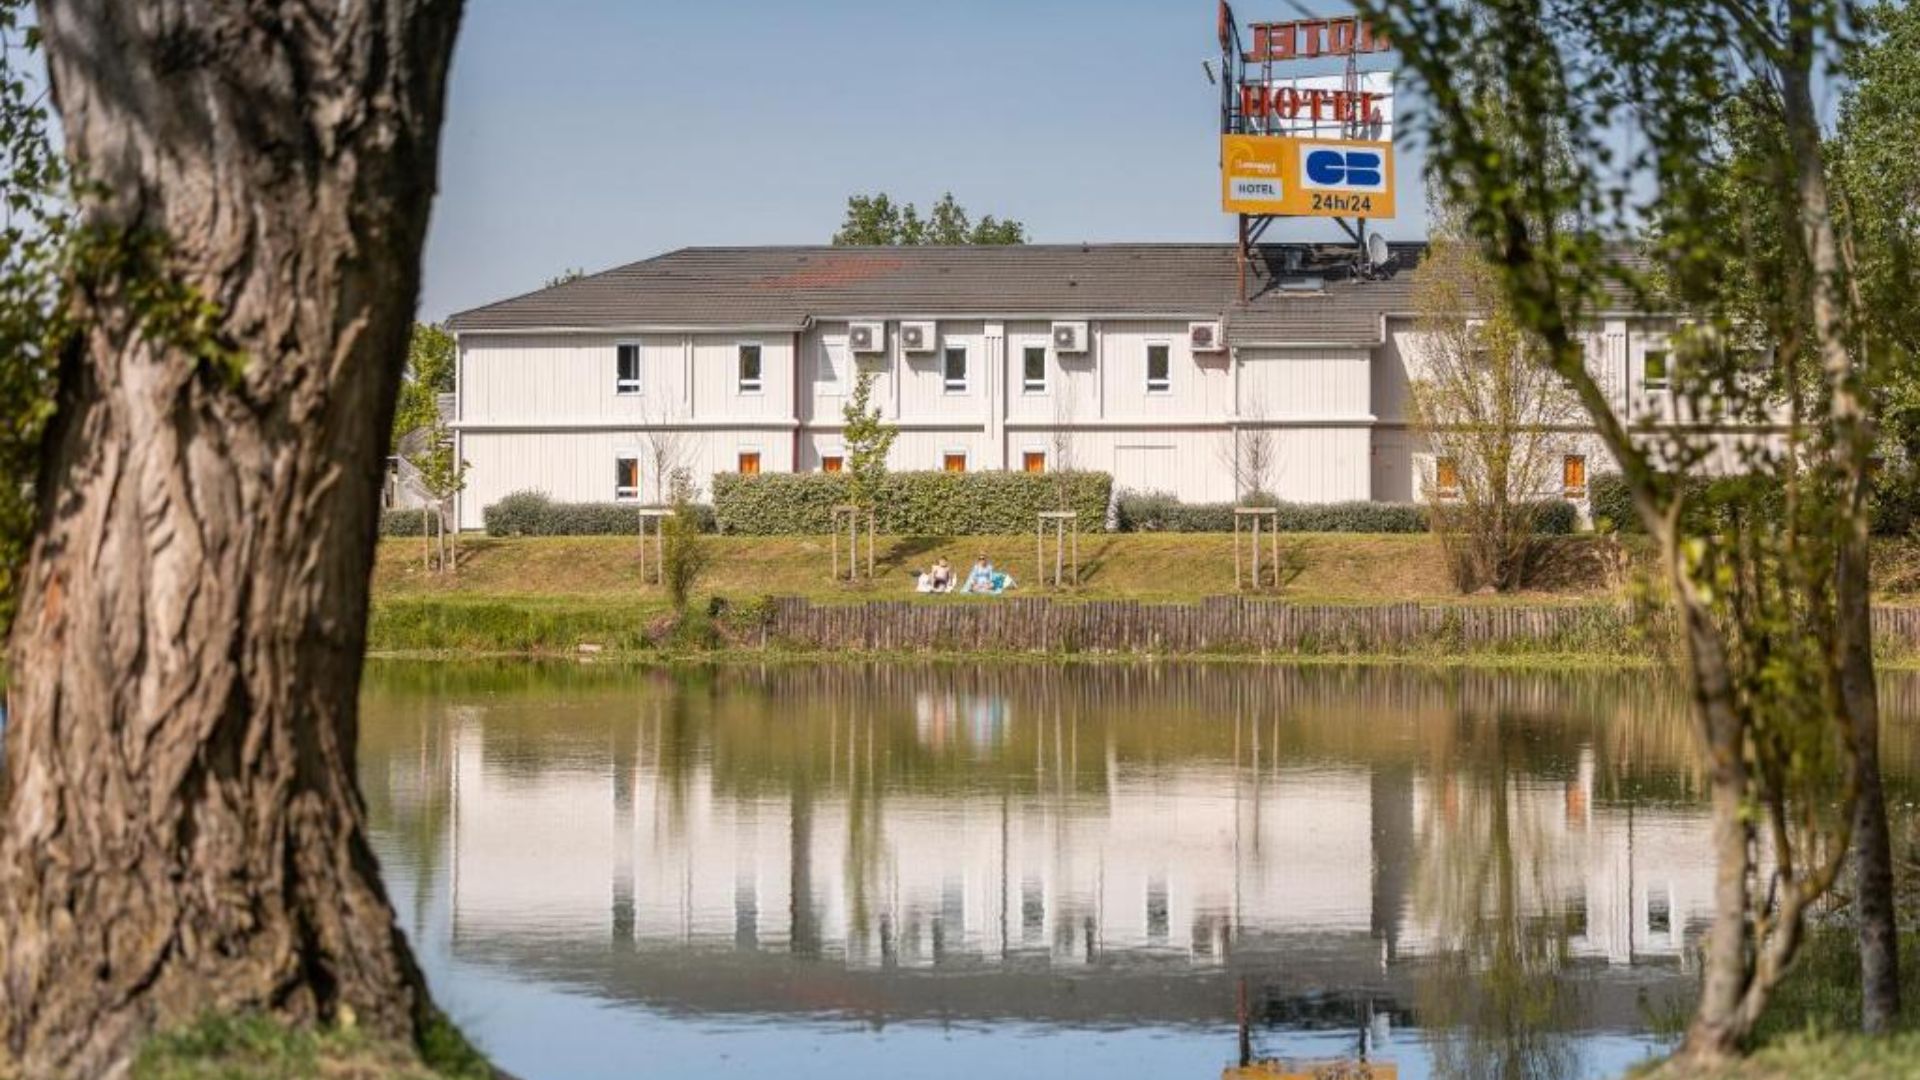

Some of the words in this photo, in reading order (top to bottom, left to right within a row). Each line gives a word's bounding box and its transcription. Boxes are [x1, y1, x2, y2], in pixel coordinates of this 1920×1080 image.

[1240, 84, 1382, 124] HOTEL
[1307, 150, 1381, 185] CB
[1238, 183, 1276, 195] HOTEL
[1312, 194, 1372, 211] 24h/24
